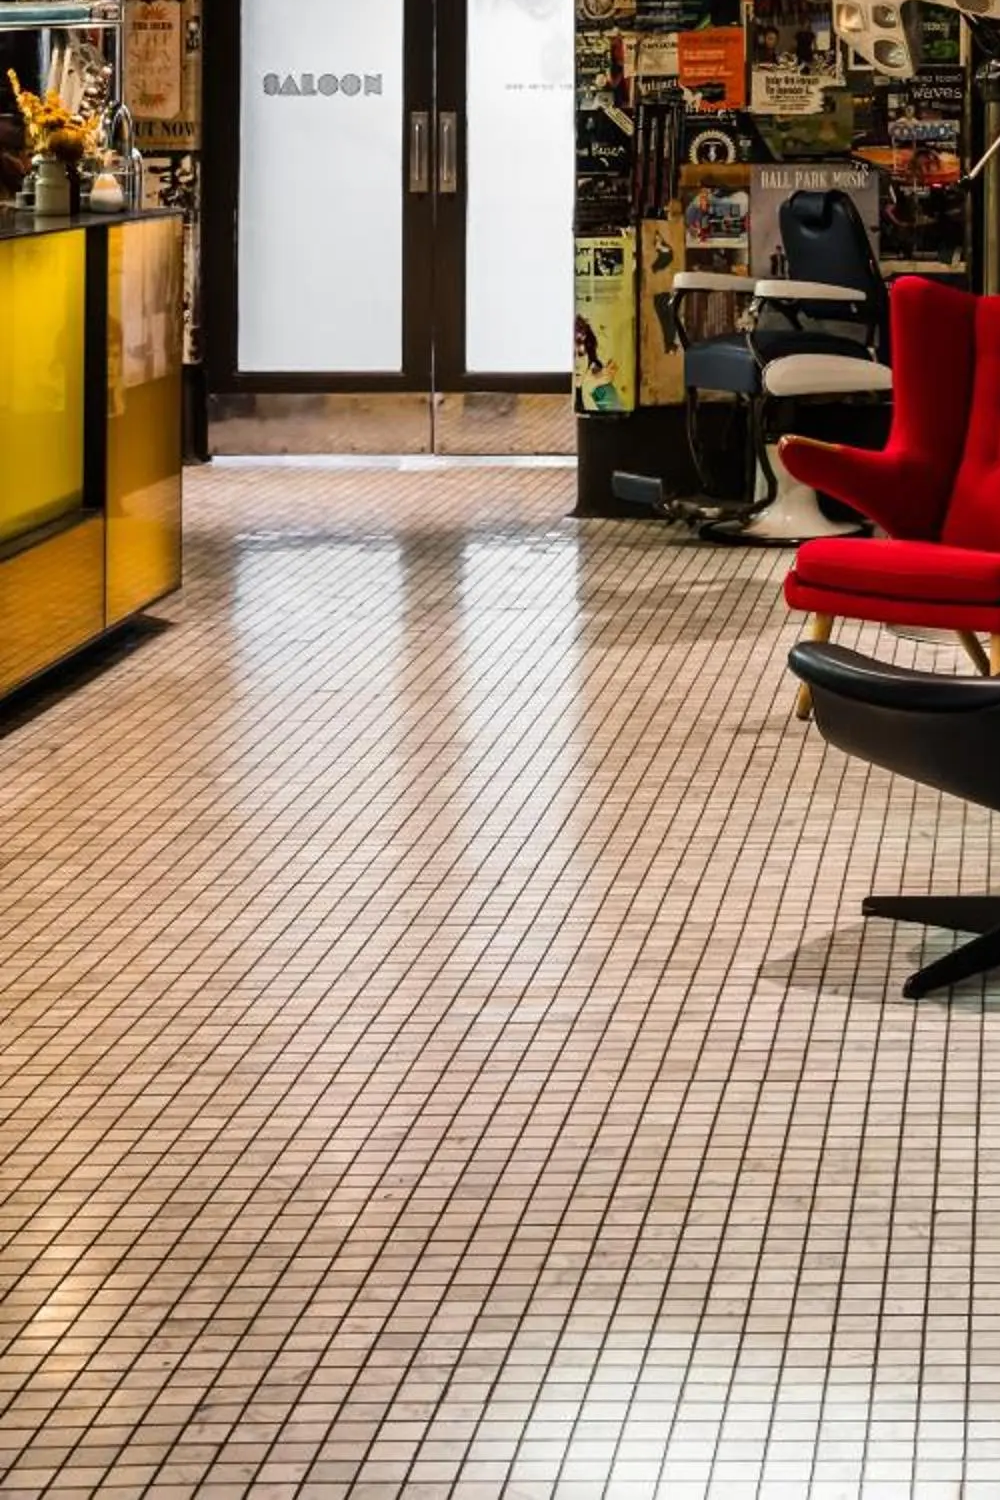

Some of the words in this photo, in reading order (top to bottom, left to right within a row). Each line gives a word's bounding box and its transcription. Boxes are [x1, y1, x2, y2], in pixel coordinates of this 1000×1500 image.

[263, 73, 383, 96] SALOON
[134, 121, 157, 136] UT
[160, 121, 195, 136] NOW
[794, 171, 827, 189] PARK
